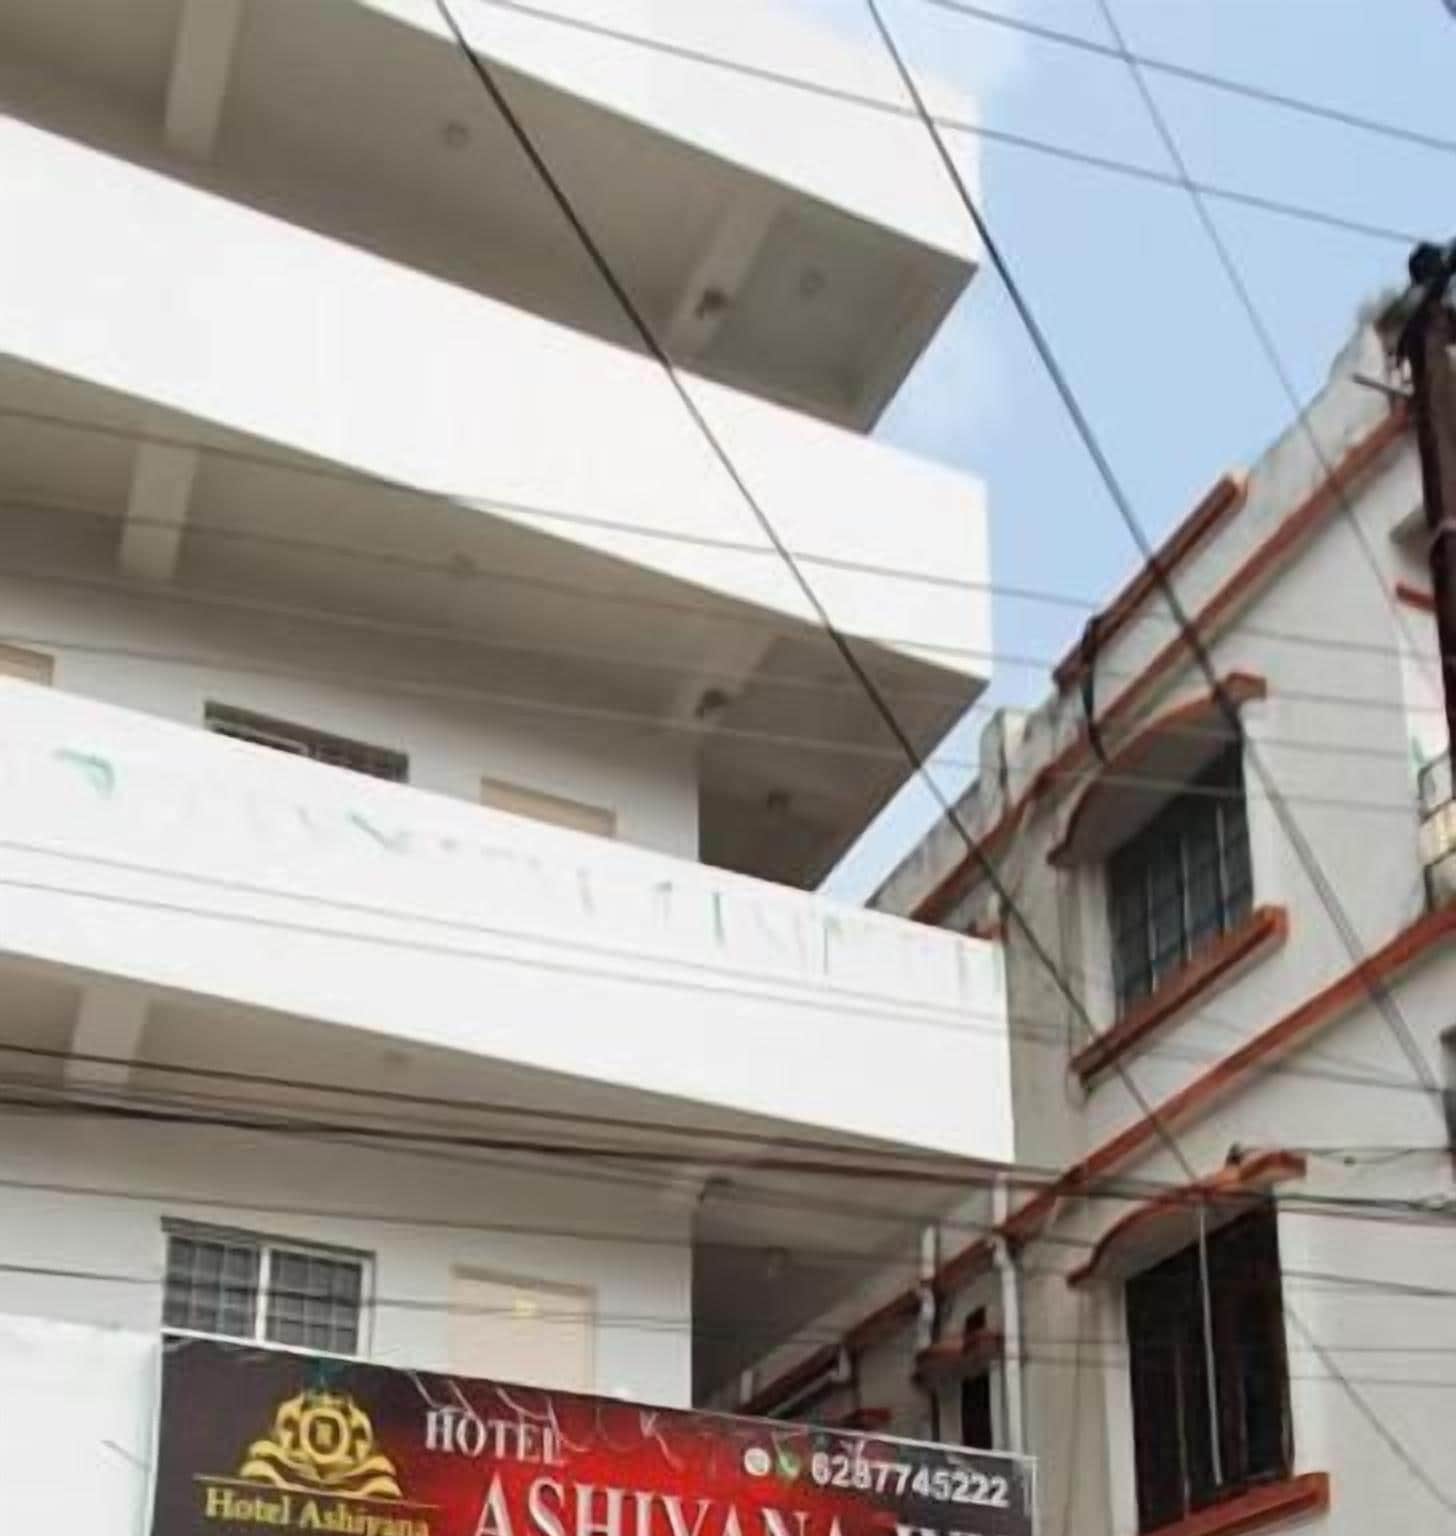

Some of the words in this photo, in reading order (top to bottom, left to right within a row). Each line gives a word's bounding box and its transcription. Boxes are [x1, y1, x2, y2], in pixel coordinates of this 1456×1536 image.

[425, 1410, 566, 1464] HOTEL
[205, 1486, 291, 1526] Hotel
[811, 1451, 1010, 1509] 6287745222
